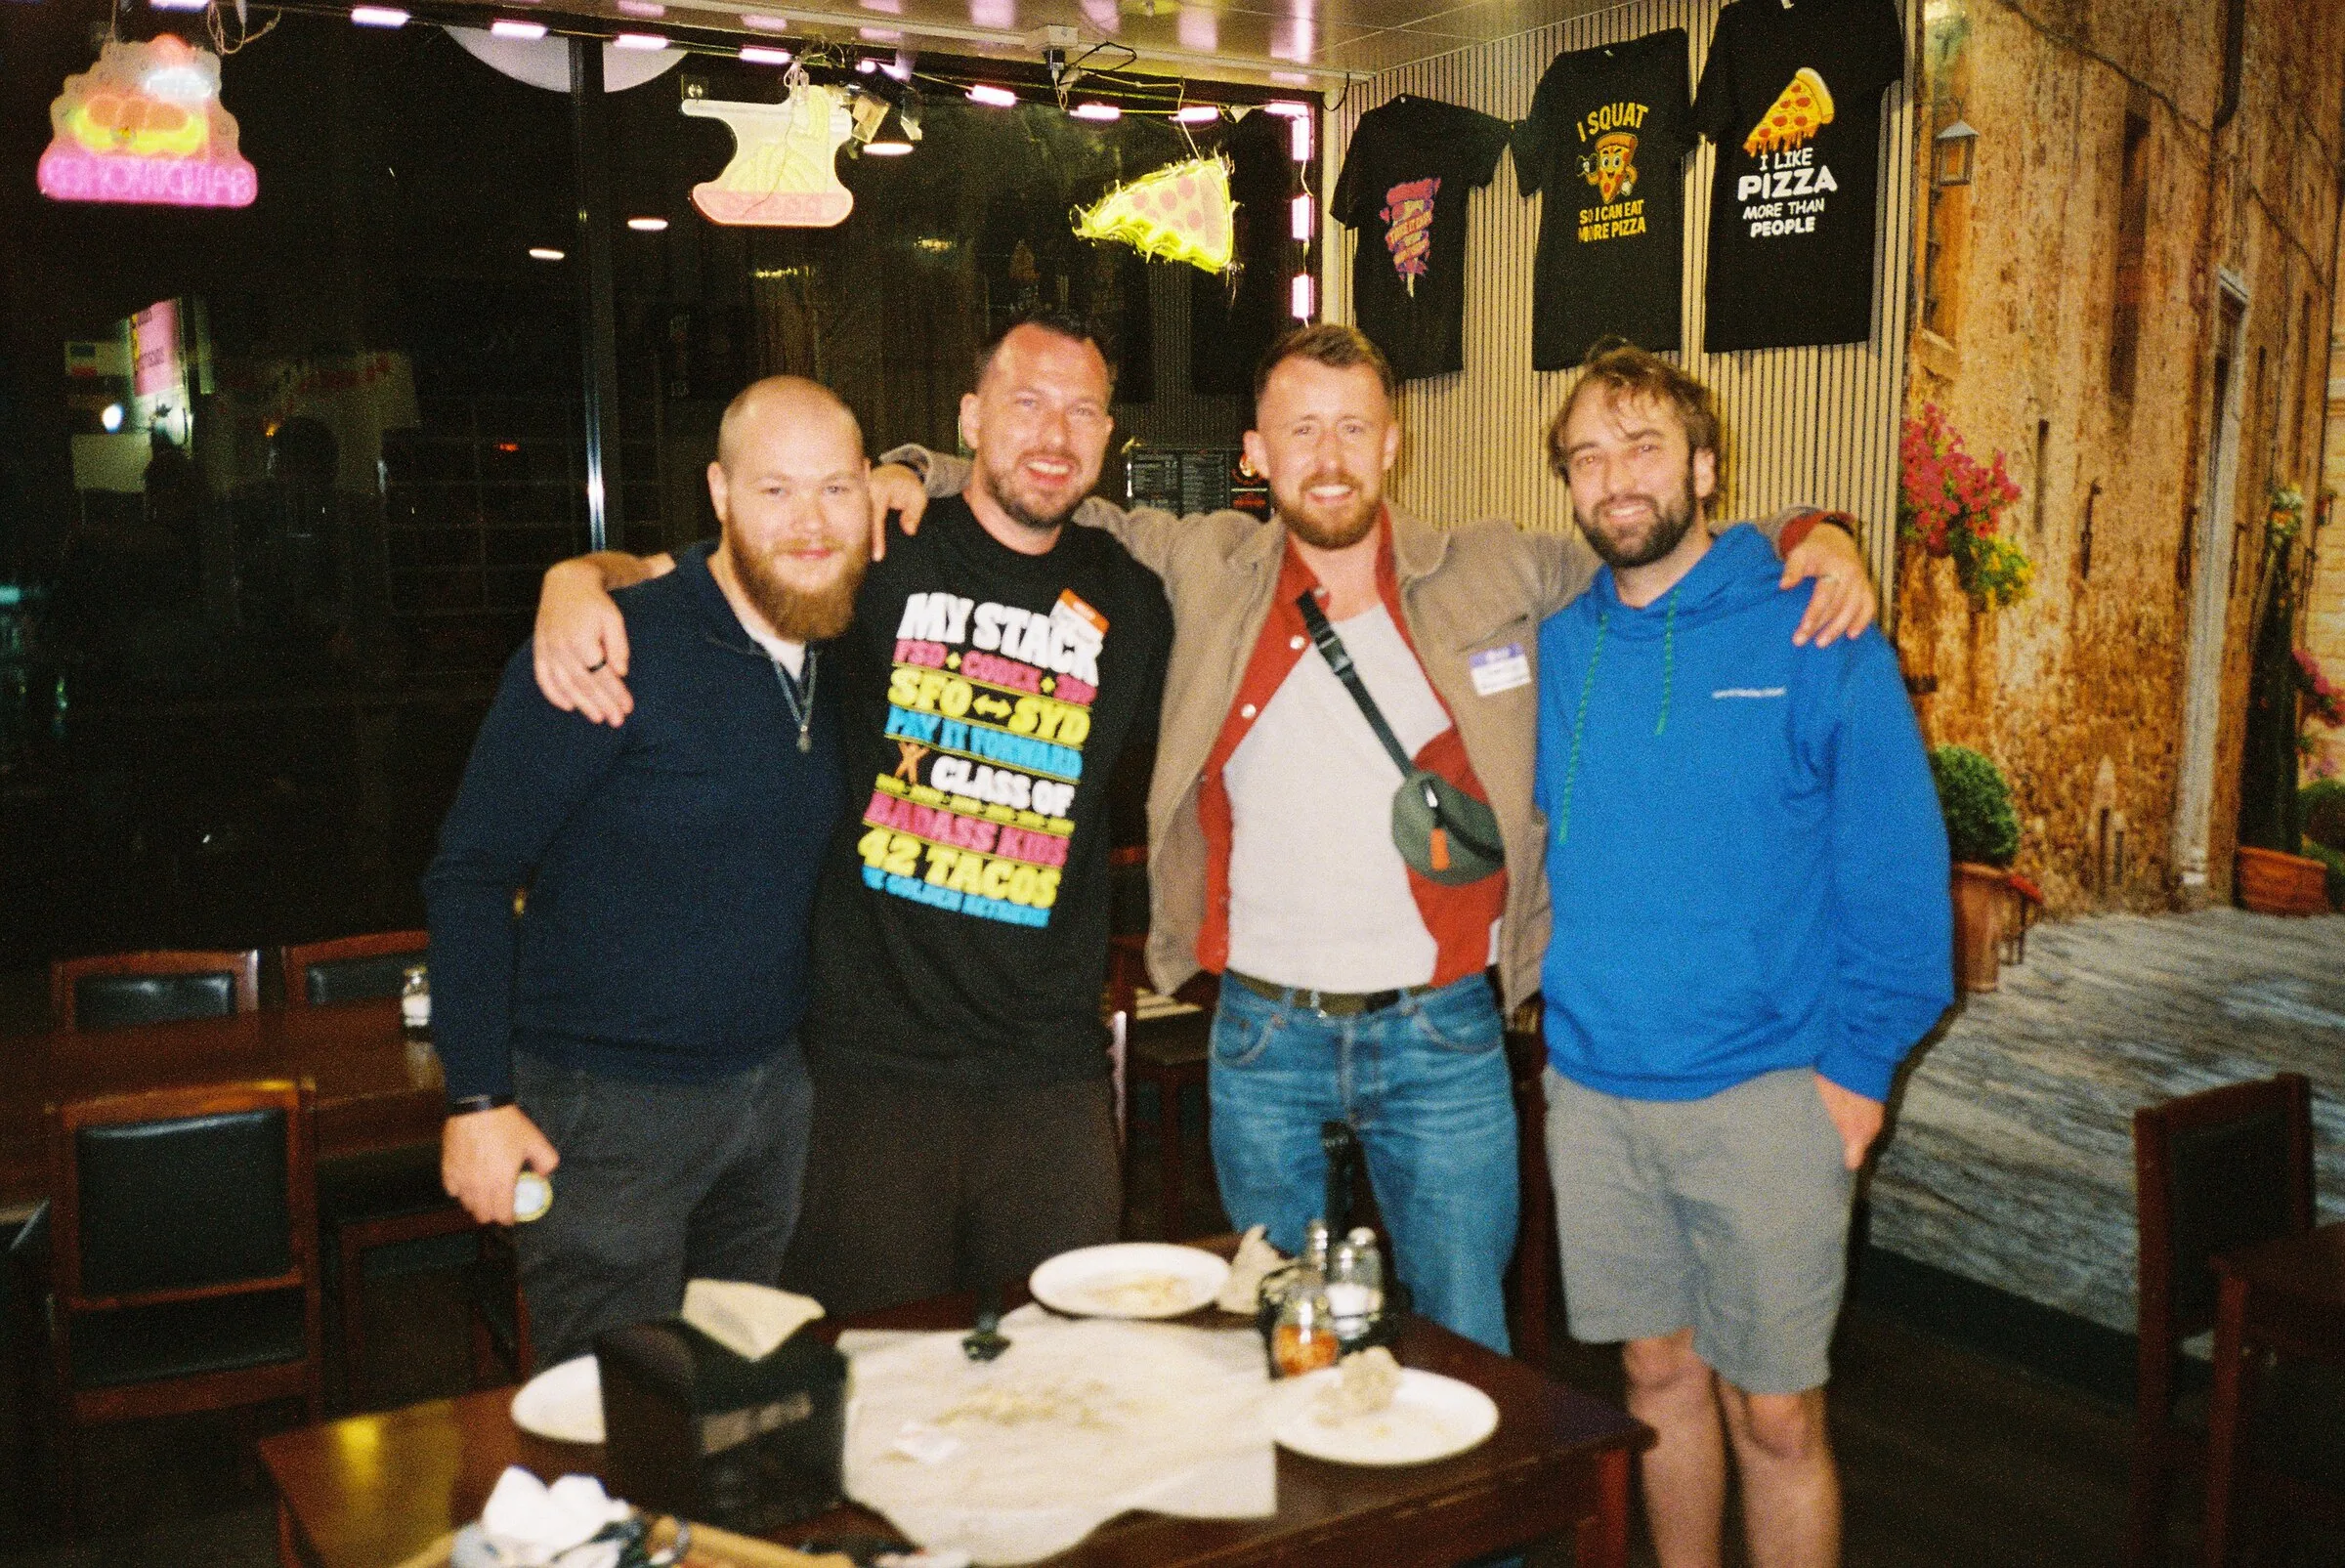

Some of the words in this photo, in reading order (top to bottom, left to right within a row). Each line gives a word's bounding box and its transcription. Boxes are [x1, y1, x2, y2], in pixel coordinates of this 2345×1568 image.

[1577, 121, 1587, 143] I
[1587, 103, 1649, 135] SQUAT
[1759, 154, 1769, 171] I
[1773, 148, 1813, 170] LIKE
[1737, 165, 1838, 201] PIZZA
[1595, 207, 1599, 222] I
[1600, 203, 1623, 221] CAN
[1624, 199, 1645, 217] EAT
[1742, 202, 1784, 220] MORE
[1787, 197, 1826, 215] THAN
[1750, 216, 1816, 237] PEOPLE
[1577, 222, 1610, 242] MORE
[1610, 216, 1646, 237] PIZZA
[896, 592, 975, 644] MY
[972, 602, 1103, 687] STACK
[887, 668, 973, 718] SFO
[1007, 697, 1091, 745] SYD
[930, 755, 1032, 810] CLASS
[1031, 780, 1076, 818] OF
[857, 827, 922, 877] 42
[924, 844, 1063, 909] TACOS
